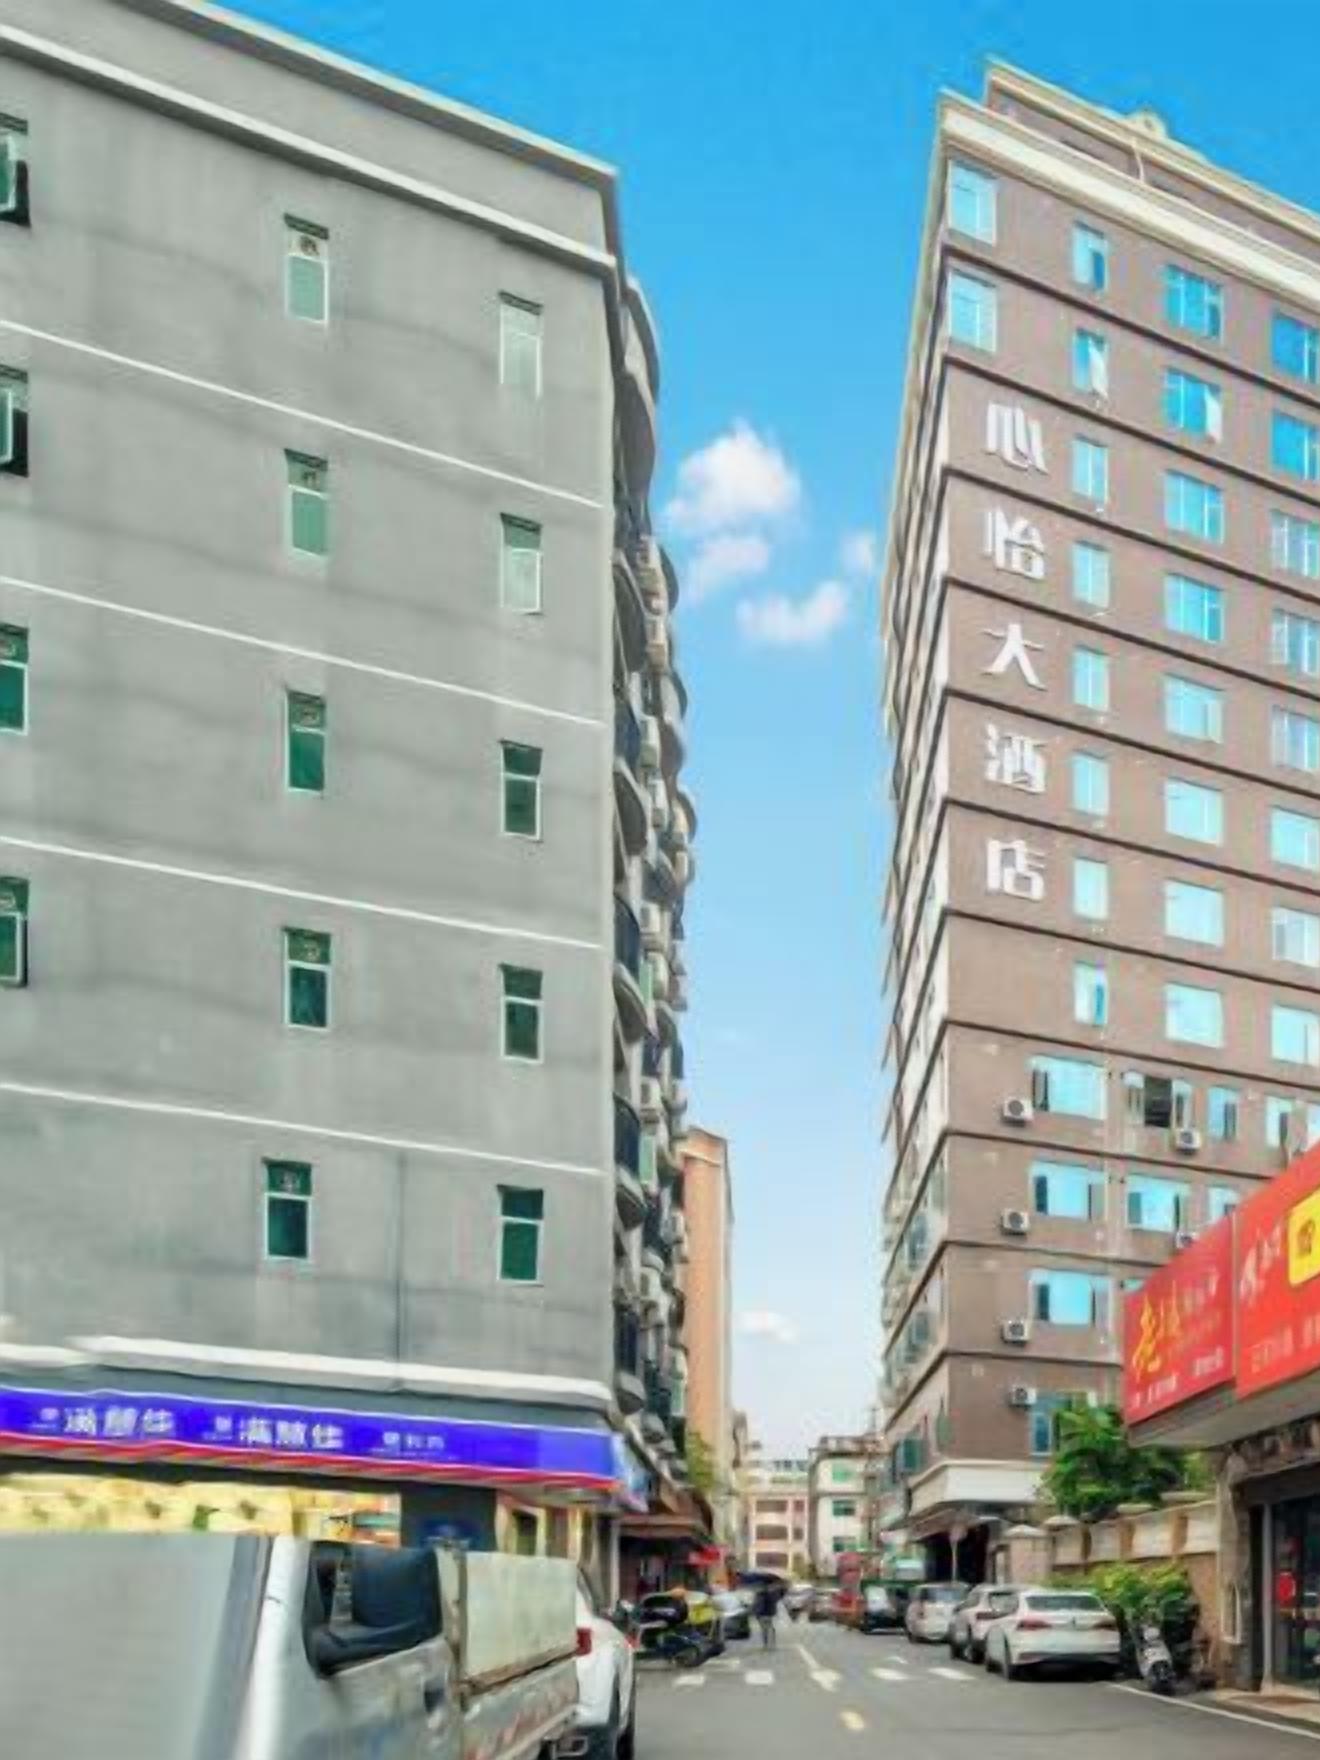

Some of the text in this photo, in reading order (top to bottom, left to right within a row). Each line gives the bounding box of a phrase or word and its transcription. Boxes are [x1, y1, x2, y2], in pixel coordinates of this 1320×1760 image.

[983, 402, 1048, 903] 心怡大酒店
